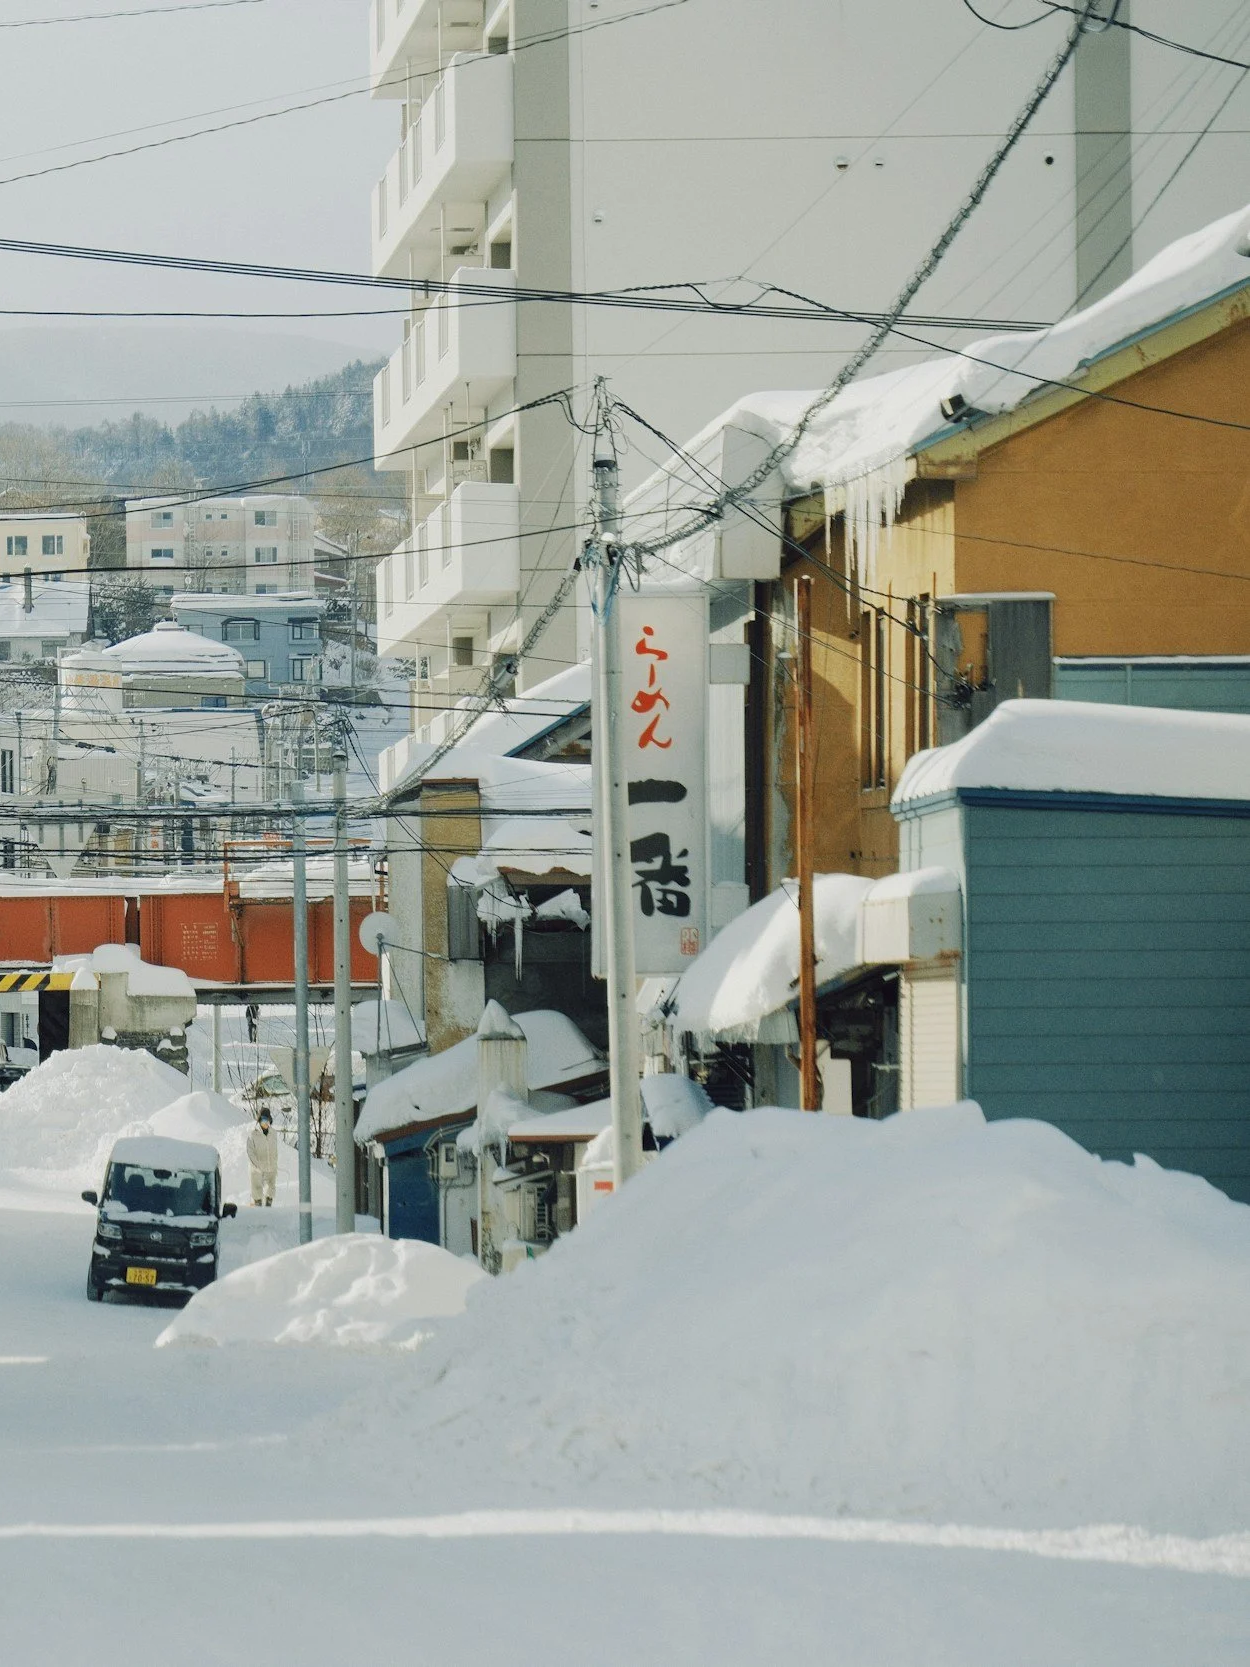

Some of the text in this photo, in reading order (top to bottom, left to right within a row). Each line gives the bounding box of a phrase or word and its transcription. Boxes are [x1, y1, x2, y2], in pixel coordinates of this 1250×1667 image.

[628, 626, 692, 917] らーめん 一番
